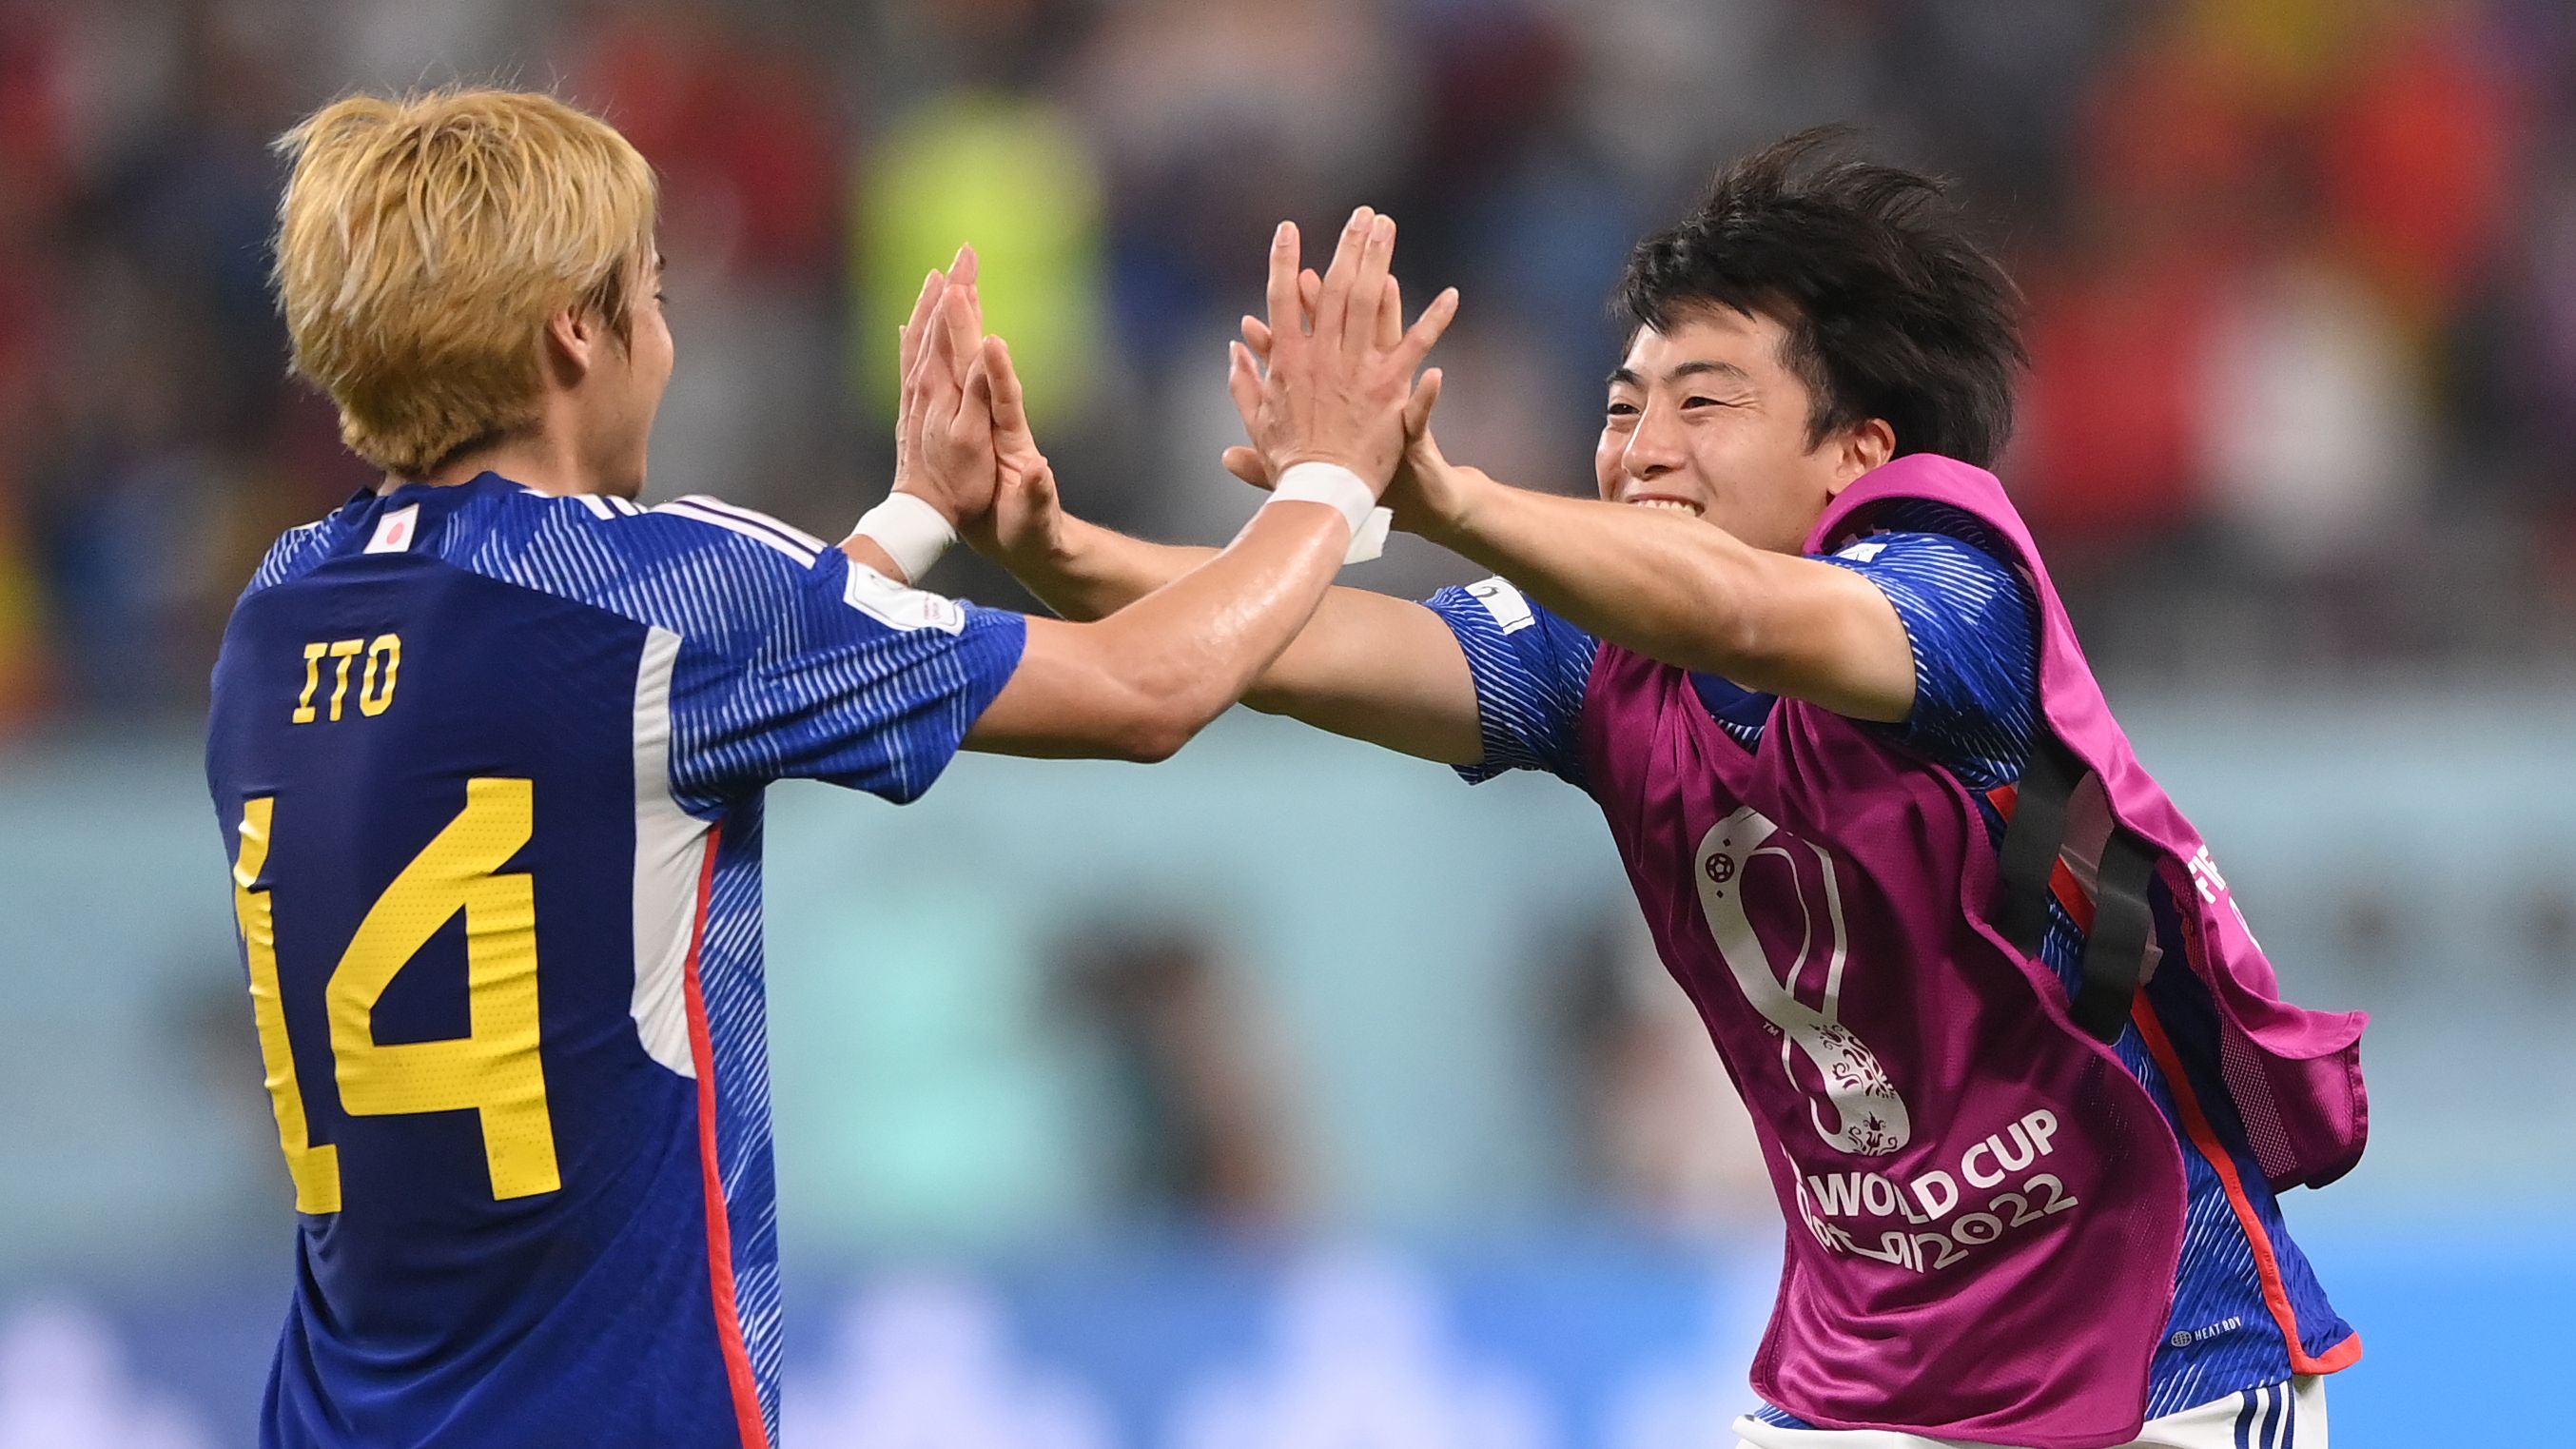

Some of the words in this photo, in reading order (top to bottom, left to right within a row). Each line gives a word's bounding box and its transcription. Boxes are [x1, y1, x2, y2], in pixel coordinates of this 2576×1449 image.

[292, 634, 401, 724] ITO
[234, 777, 562, 1215] 14
[1807, 1170, 1960, 1224] WOLD
[1961, 1108, 2059, 1189] CUP
